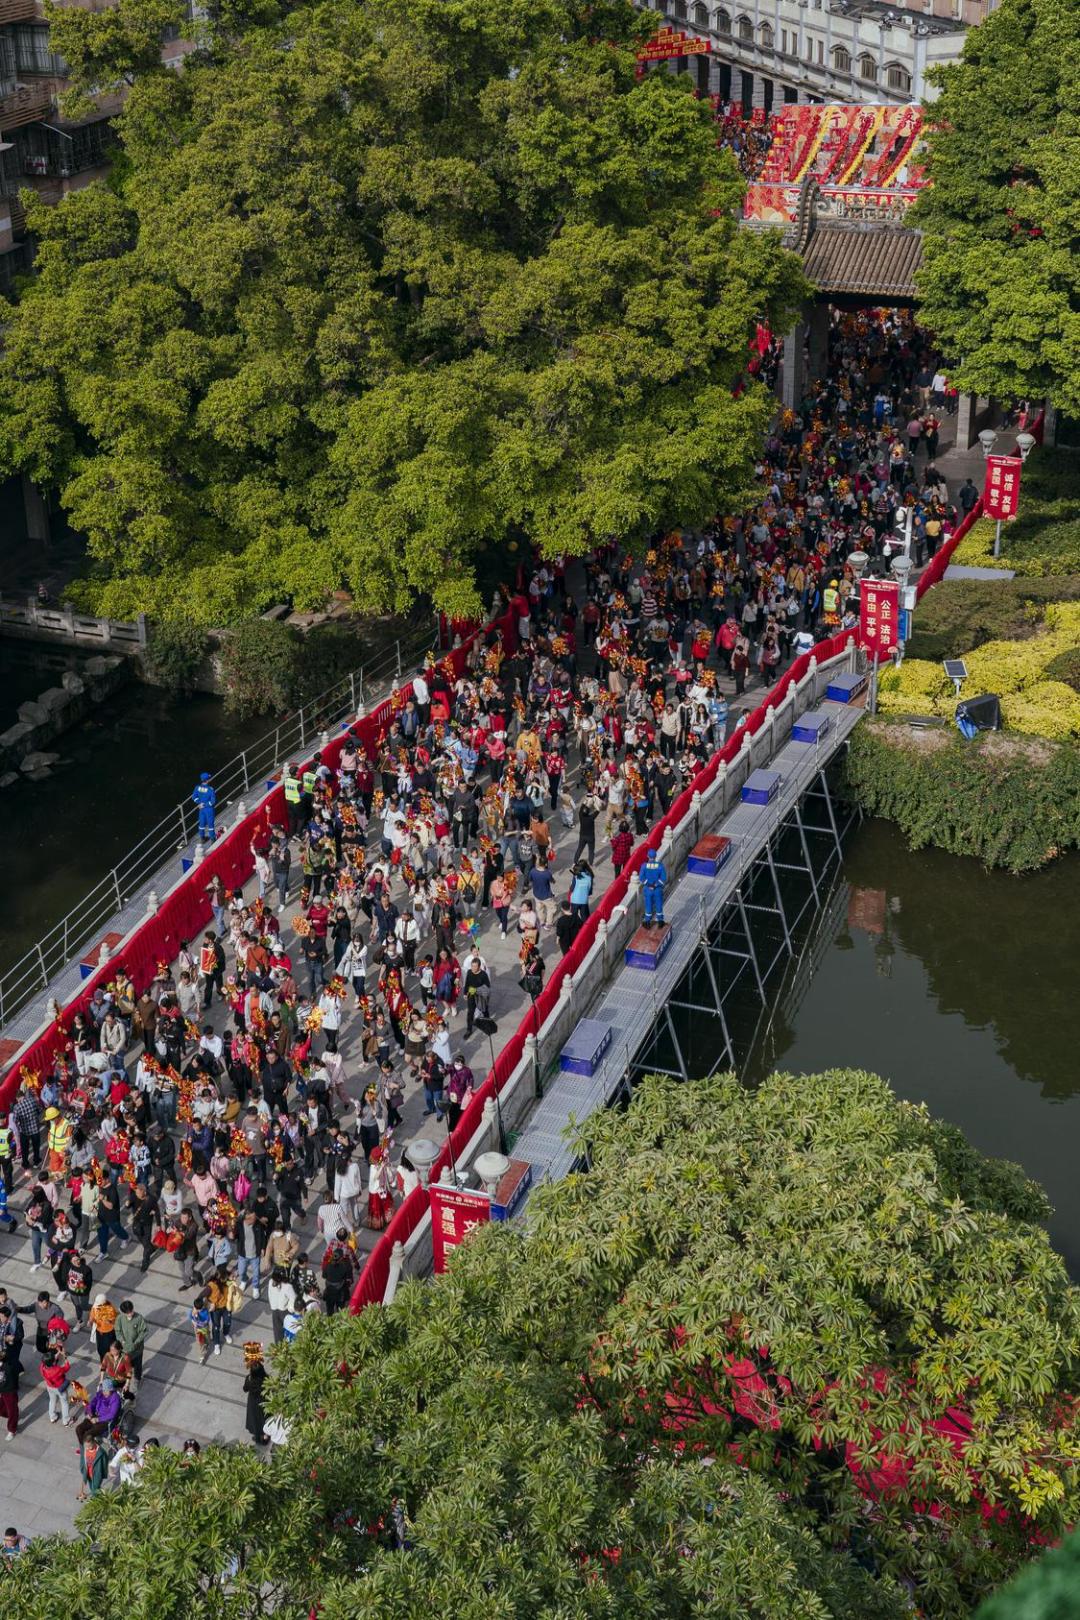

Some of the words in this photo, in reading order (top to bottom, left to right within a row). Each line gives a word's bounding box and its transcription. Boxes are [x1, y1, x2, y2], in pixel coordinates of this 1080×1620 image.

[1003, 473, 1014, 491] 诚信
[867, 592, 877, 613] 自由
[880, 600, 891, 619] 公正
[866, 617, 877, 638] 平等
[880, 624, 891, 645] 法治
[441, 1207, 456, 1237] 富强
